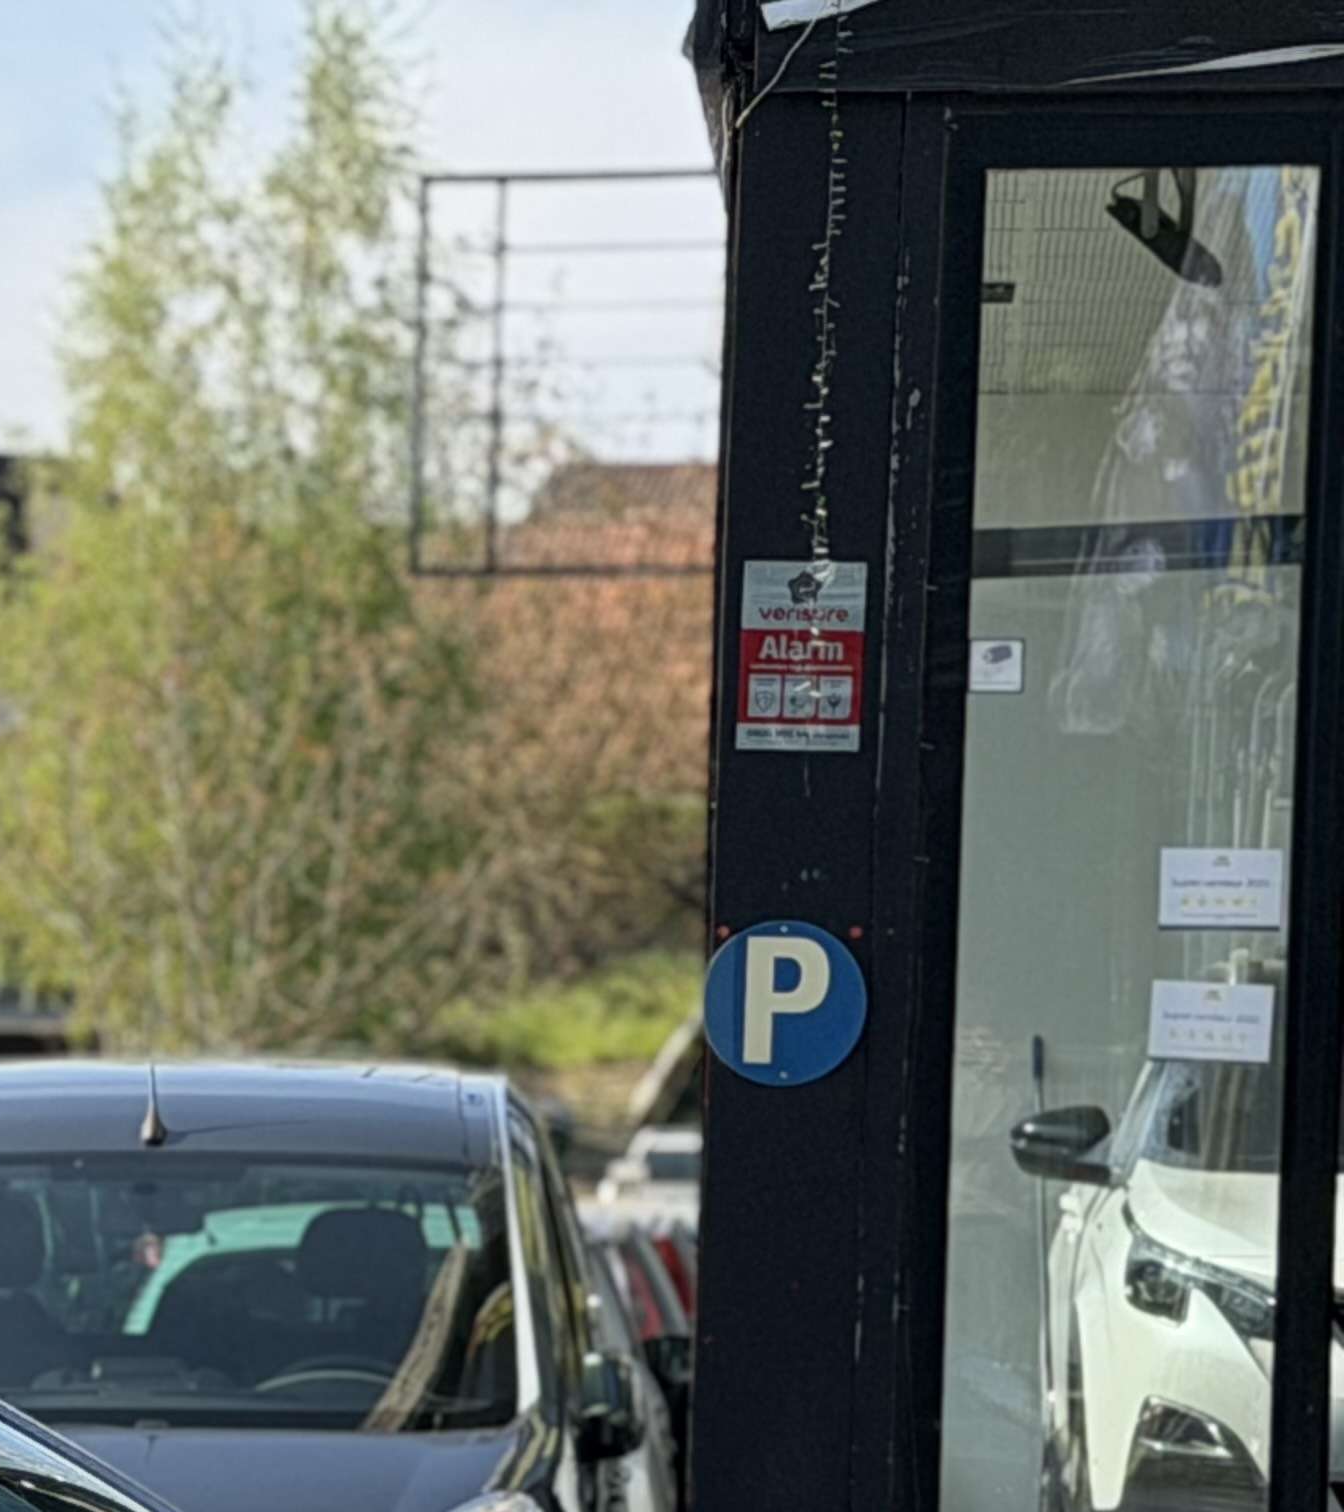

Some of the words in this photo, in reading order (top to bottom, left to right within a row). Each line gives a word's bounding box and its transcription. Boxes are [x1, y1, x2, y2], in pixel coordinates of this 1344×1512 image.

[758, 605, 849, 622] verisure
[759, 634, 844, 661] Alarm
[743, 936, 830, 1064] P
